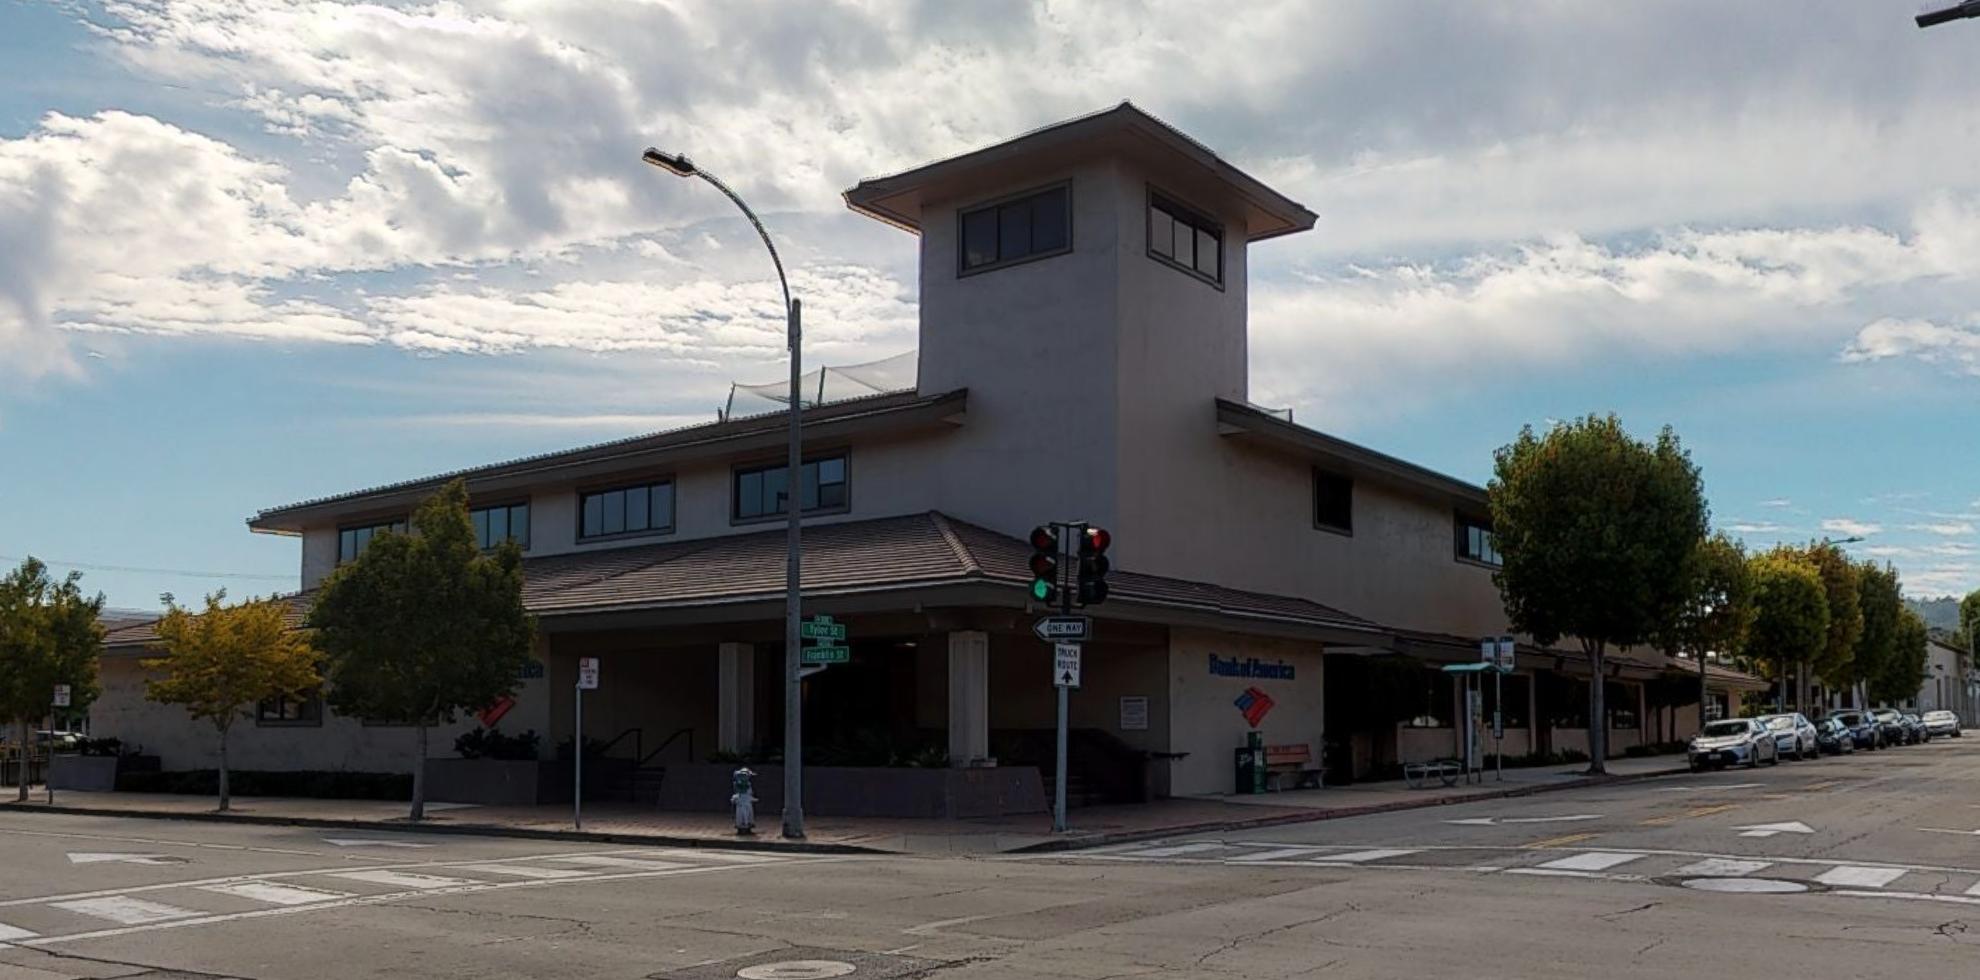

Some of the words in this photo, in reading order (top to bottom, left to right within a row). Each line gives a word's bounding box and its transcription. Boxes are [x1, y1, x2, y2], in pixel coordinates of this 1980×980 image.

[1046, 624, 1064, 633] ONE
[1065, 624, 1083, 633] WAY
[807, 650, 834, 660] Franklin
[1058, 647, 1078, 658] TRUCK
[1058, 660, 1078, 671] ROUTE
[1208, 652, 1239, 677] Bank
[1252, 658, 1295, 680] America
